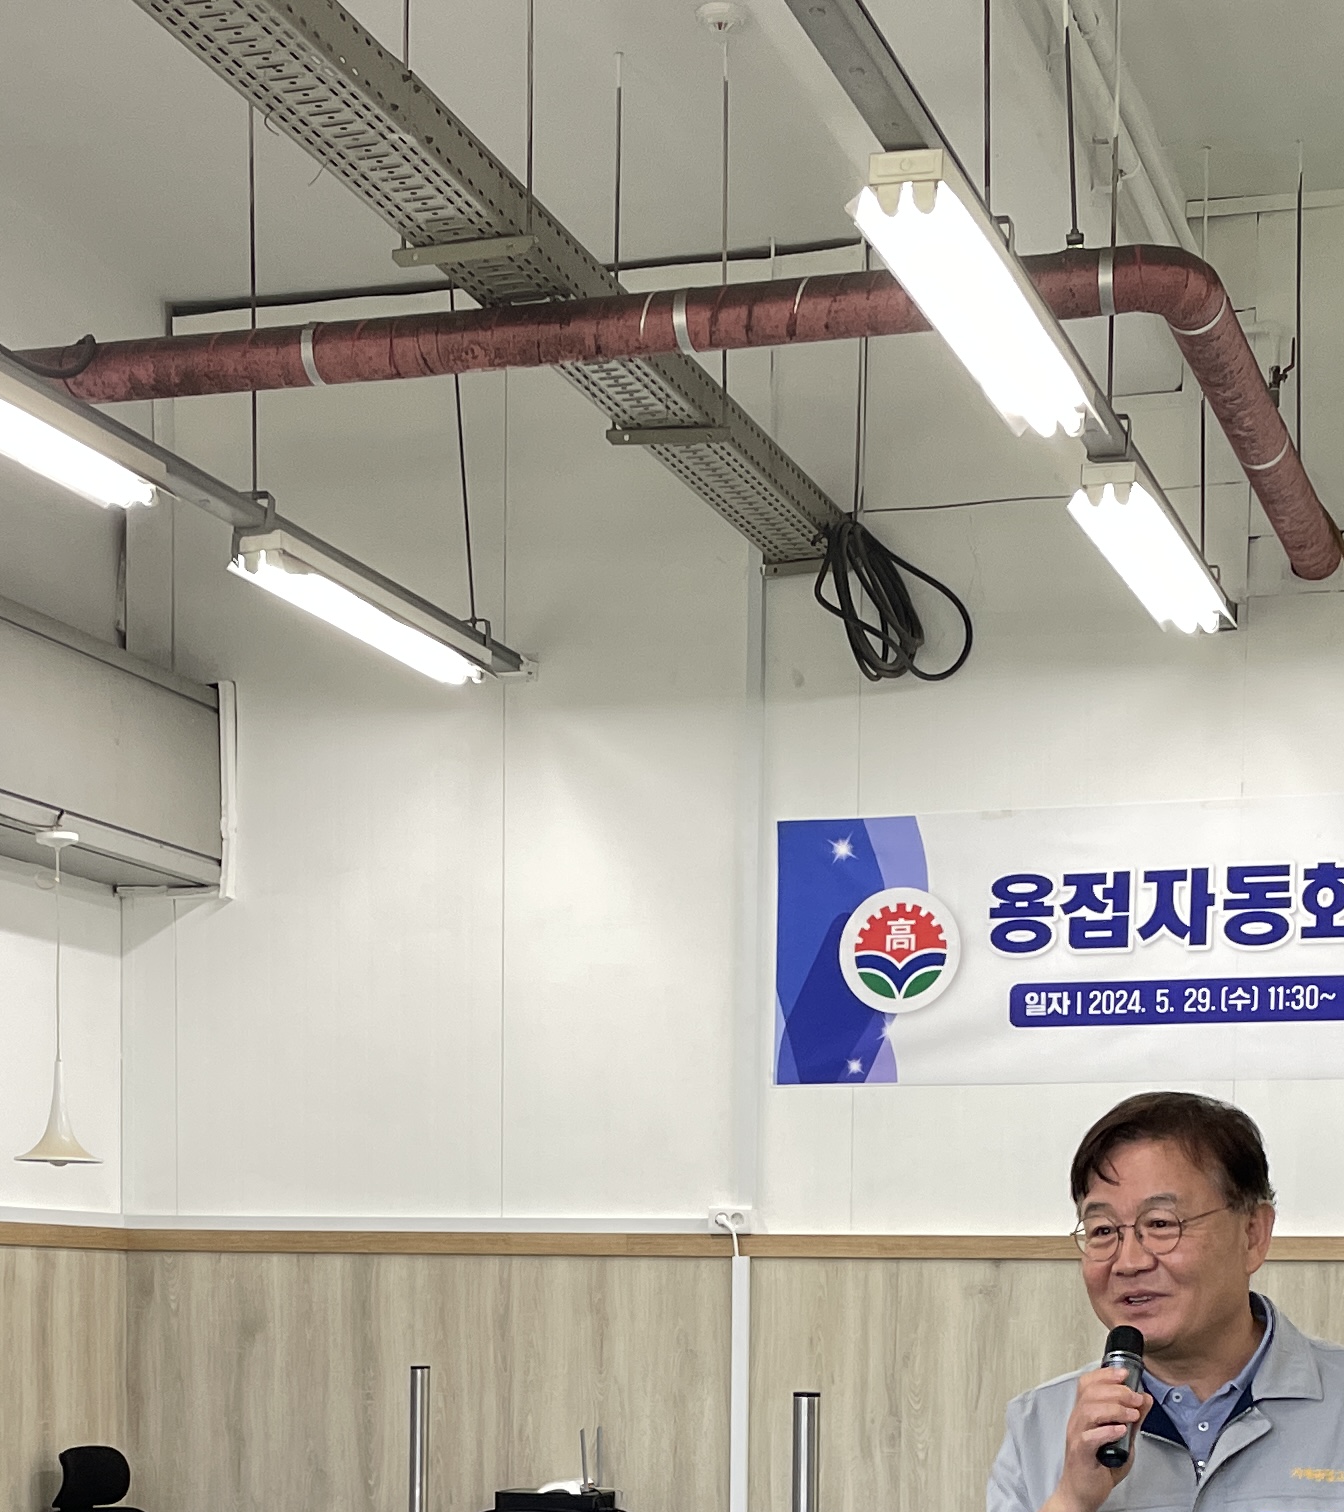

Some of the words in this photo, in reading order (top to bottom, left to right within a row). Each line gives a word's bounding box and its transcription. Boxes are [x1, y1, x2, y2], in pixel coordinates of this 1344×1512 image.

[885, 917, 917, 952] 高
[1024, 991, 1071, 1017] 일자
[1088, 989, 1146, 1015] 2024.
[1155, 988, 1175, 1014] 5.
[1268, 984, 1337, 1011] 11:30~
